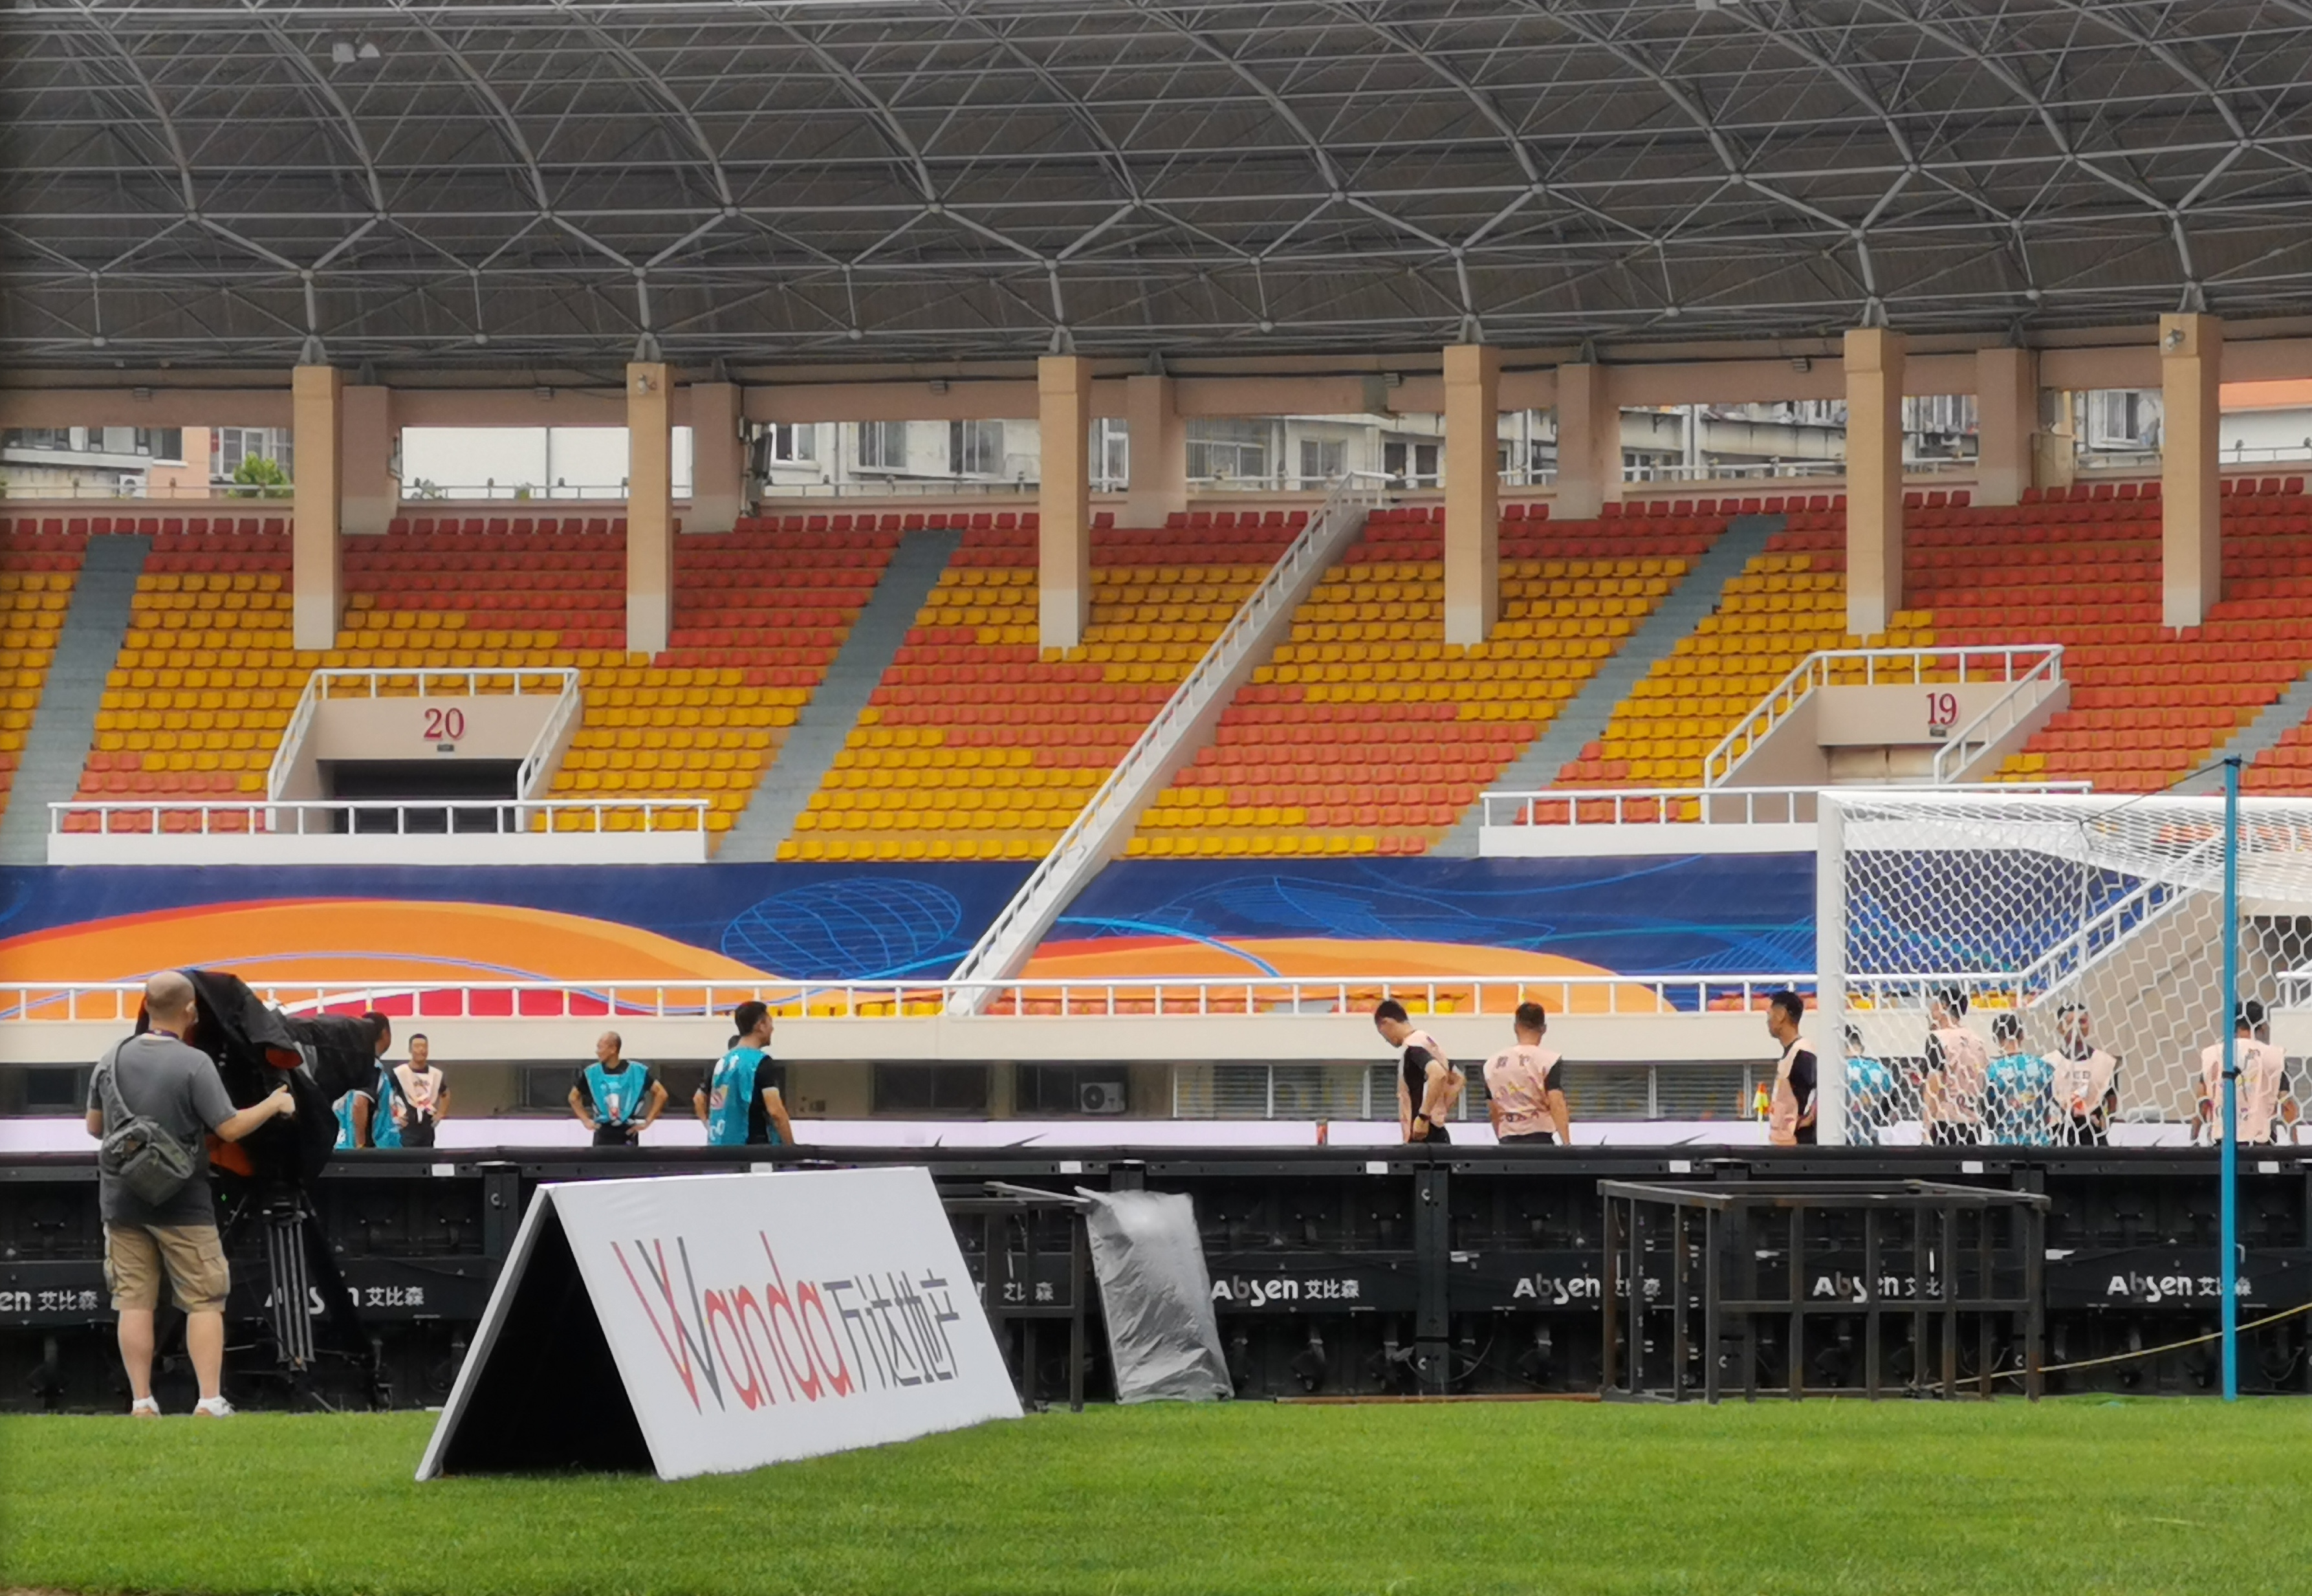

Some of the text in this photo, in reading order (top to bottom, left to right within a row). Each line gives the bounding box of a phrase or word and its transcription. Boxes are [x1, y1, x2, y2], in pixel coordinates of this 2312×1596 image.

[424, 707, 465, 739] 20
[1926, 692, 1958, 726] 19
[38, 1289, 98, 1311] 艾比森
[365, 1286, 424, 1307] 艾比森
[1211, 1274, 1359, 1307] Absen 艾比森
[1512, 1273, 1600, 1305] Absen
[2106, 1271, 2192, 1302] Absen
[610, 1230, 960, 1416] Wanda 万达地产
